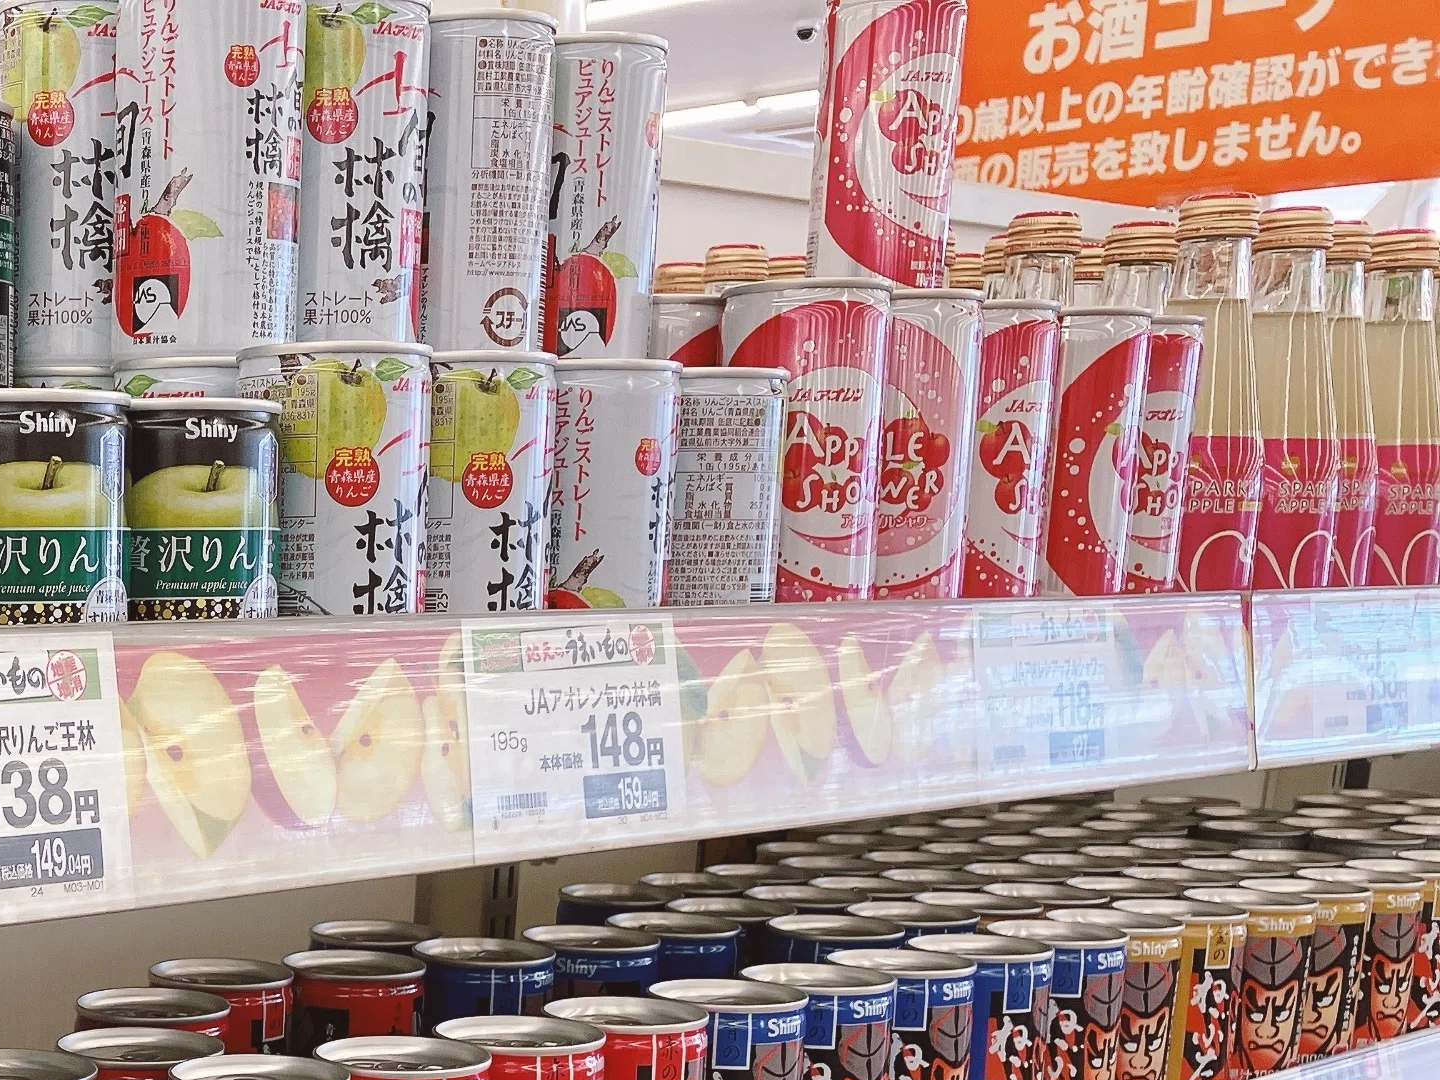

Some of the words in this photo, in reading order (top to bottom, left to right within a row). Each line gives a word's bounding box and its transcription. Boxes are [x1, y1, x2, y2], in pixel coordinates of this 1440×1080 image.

[1023, 0, 1334, 74] お酒コー
[34, 91, 66, 107] 完熟
[315, 88, 351, 107] 完熟
[956, 38, 1440, 145] 0歳以上の年齢確認ができ
[30, 110, 72, 126] 青森県産
[310, 108, 355, 123] 青森県産
[35, 125, 65, 138] りんご
[315, 122, 350, 136] りんご
[29, 291, 94, 307] ストレート
[306, 291, 374, 306] ストレート
[28, 309, 92, 326] 果汁100%
[304, 309, 372, 325] 果汁100%
[19, 411, 76, 437] Shiny
[185, 418, 238, 442] Shiny
[335, 447, 372, 467] 完熟
[471, 453, 506, 471] 完熟
[573, 387, 595, 542] りんごストレート
[328, 472, 378, 485] 青森県産
[463, 474, 509, 488] 青森県産
[686, 474, 733, 482] エネルギー
[335, 485, 372, 500] りんご
[469, 486, 506, 501] りんご
[38, 582, 65, 596] apple
[155, 579, 199, 591] Premium
[201, 579, 227, 594] apple
[491, 731, 528, 752] 195g
[540, 752, 583, 772] 本体価格
[581, 712, 664, 769] 148円
[63, 880, 105, 893] M03-M01
[1257, 916, 1296, 933] Shiny
[1131, 940, 1169, 957] Shiny
[1097, 951, 1125, 971] Shiny
[942, 980, 973, 1001] Shiny
[852, 998, 888, 1019] Shiny
[768, 1017, 802, 1039] Shiny
